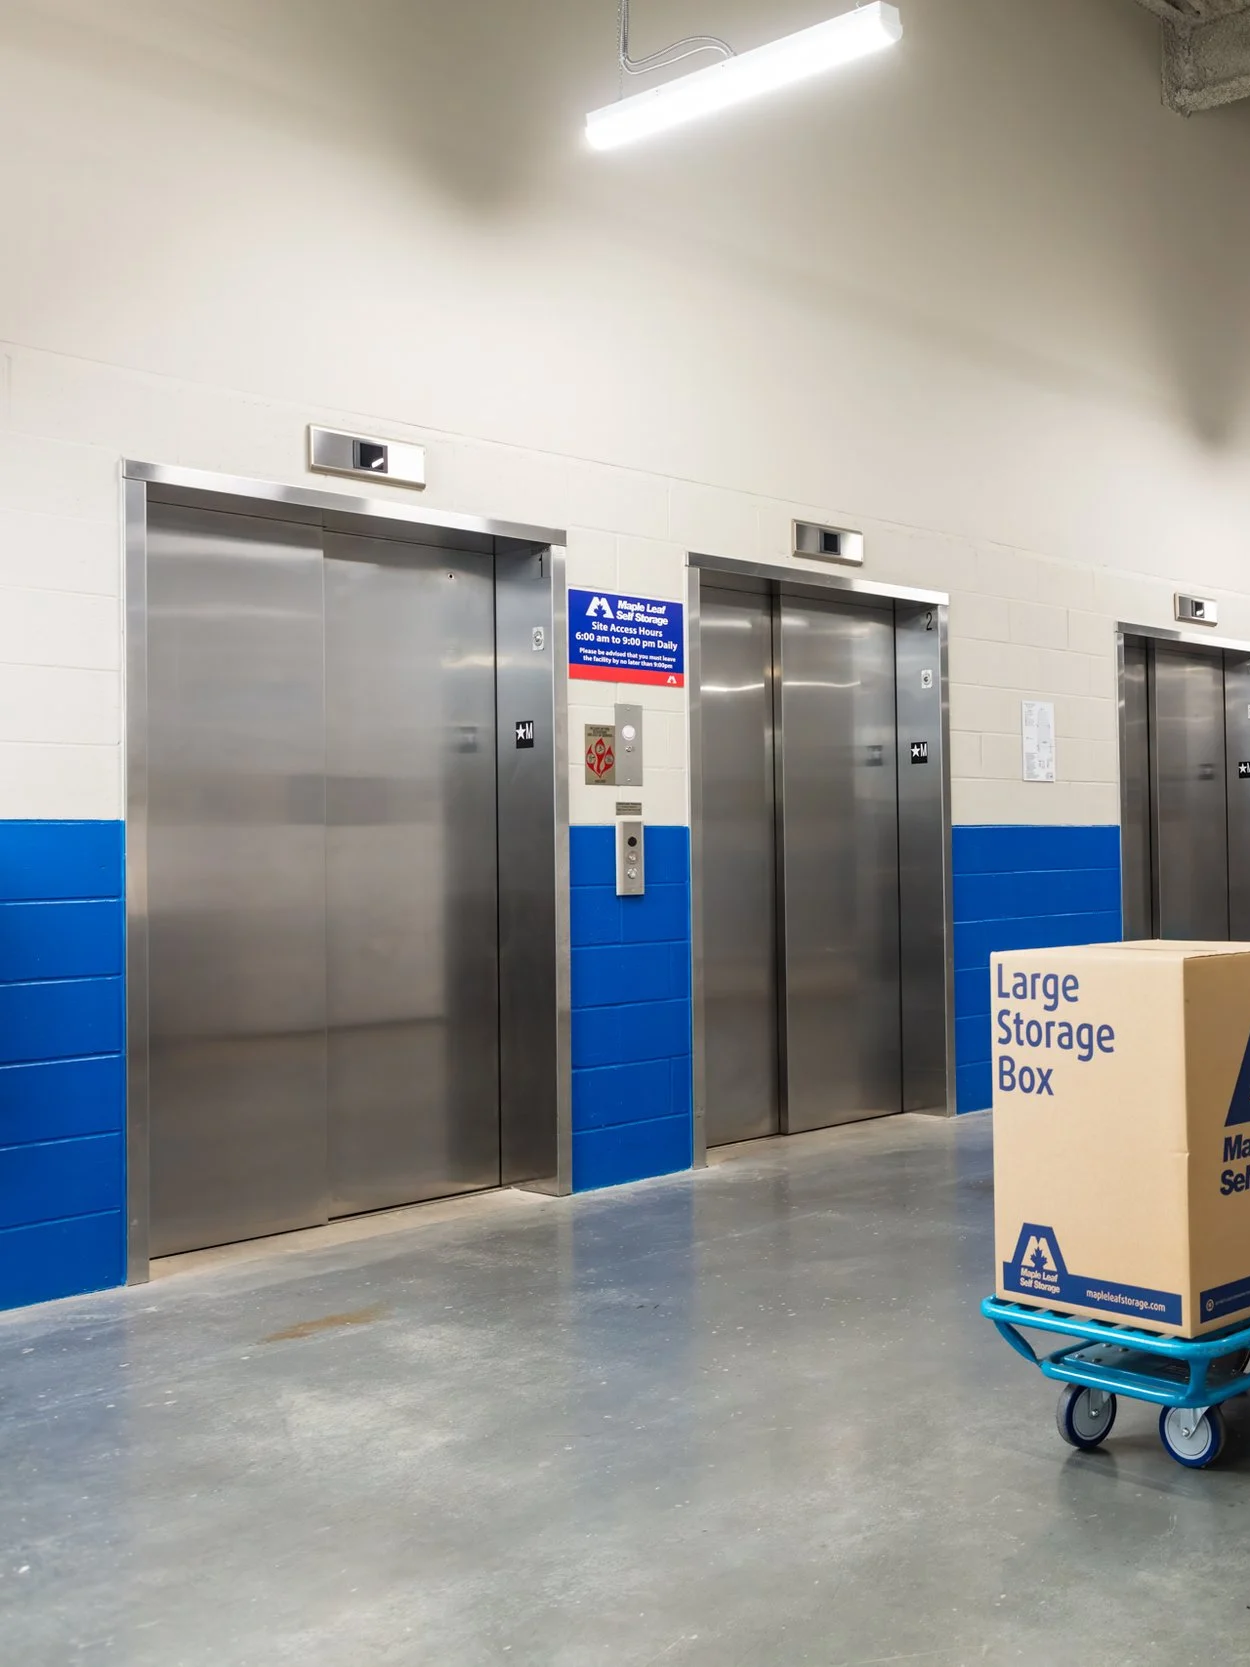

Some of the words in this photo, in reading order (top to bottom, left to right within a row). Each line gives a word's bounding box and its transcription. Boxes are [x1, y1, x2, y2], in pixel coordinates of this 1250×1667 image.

[618, 600, 645, 612] Maple
[646, 604, 666, 614] Leaf
[616, 611, 634, 620] Self
[635, 613, 668, 626] Storage
[926, 612, 933, 631] 2
[592, 621, 608, 631] Site
[610, 624, 637, 634] Access
[639, 627, 663, 637] Hours
[575, 632, 595, 641] 6:00
[612, 636, 621, 644] to
[622, 637, 641, 646] 9:00
[642, 640, 655, 648] pm
[657, 640, 678, 652] Daily
[593, 656, 611, 664] facility
[525, 723, 533, 740] M
[920, 743, 927, 757] M
[998, 963, 1079, 1012] Large
[998, 1009, 1115, 1062] Storage
[999, 1055, 1054, 1096] Box
[1021, 1267, 1041, 1280] Maple
[1043, 1271, 1058, 1283] Leaf
[1020, 1277, 1033, 1288] Self
[1034, 1280, 1060, 1294] Storage
[1086, 1288, 1165, 1312] mapleleafstorage.com
